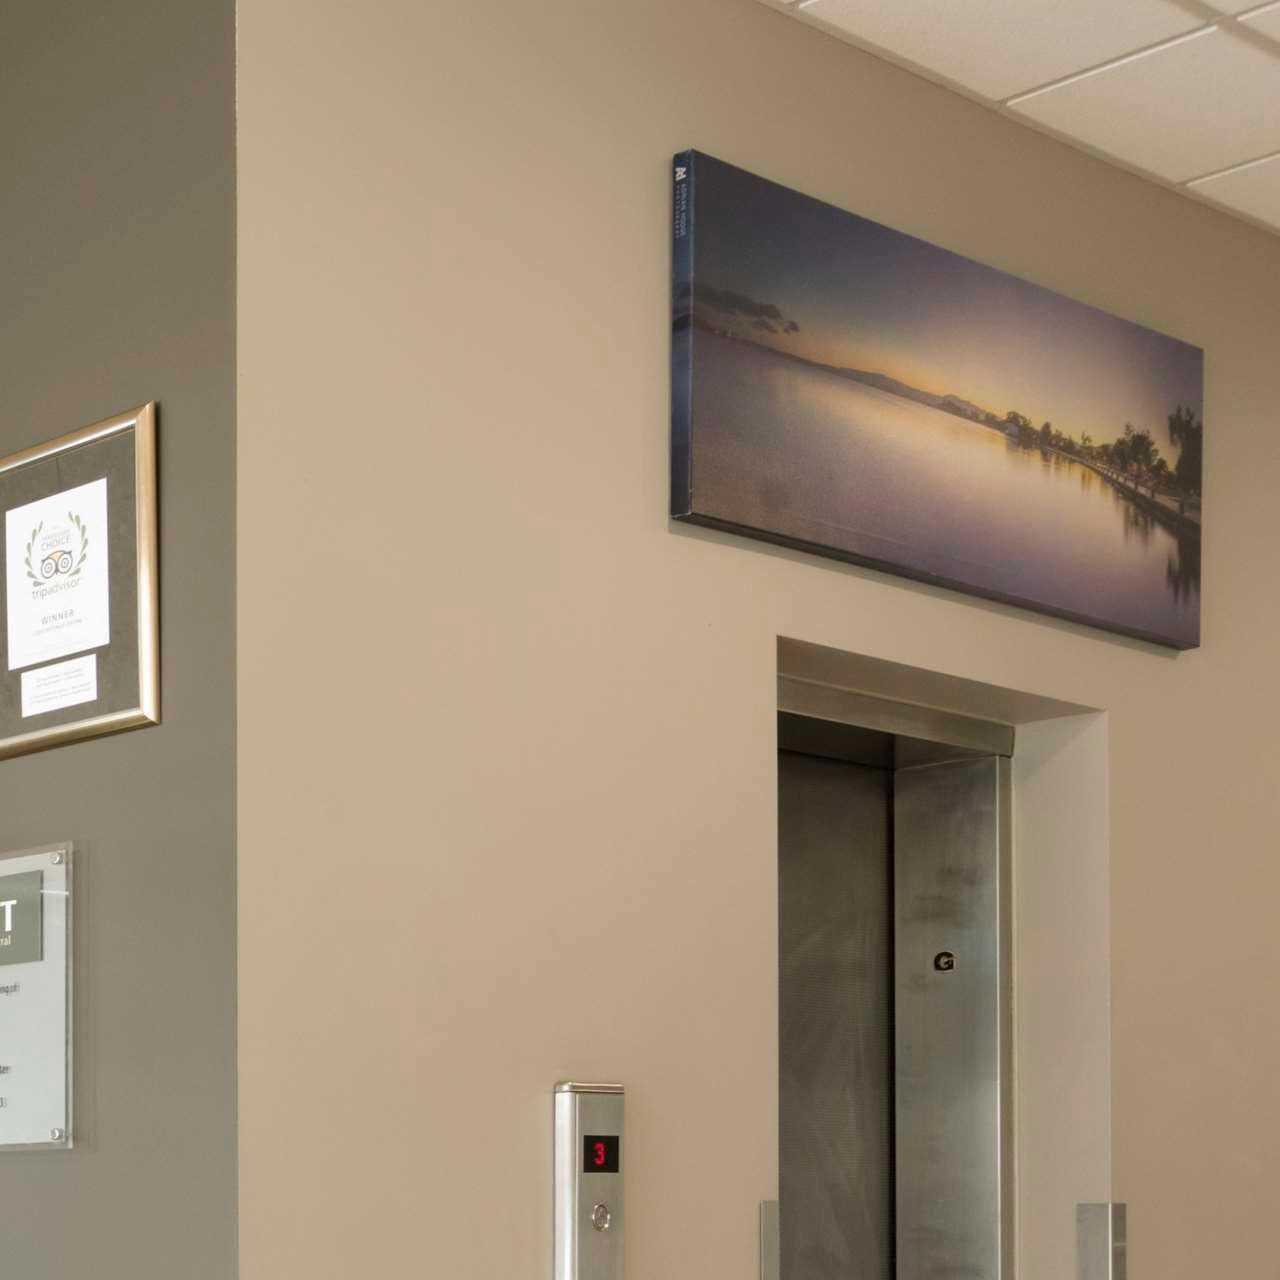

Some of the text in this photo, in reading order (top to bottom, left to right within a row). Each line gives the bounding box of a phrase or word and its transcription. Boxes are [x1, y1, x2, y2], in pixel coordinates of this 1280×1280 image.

[41, 609, 75, 625] WINNER
[934, 951, 954, 971] G
[593, 1141, 606, 1166] 3
